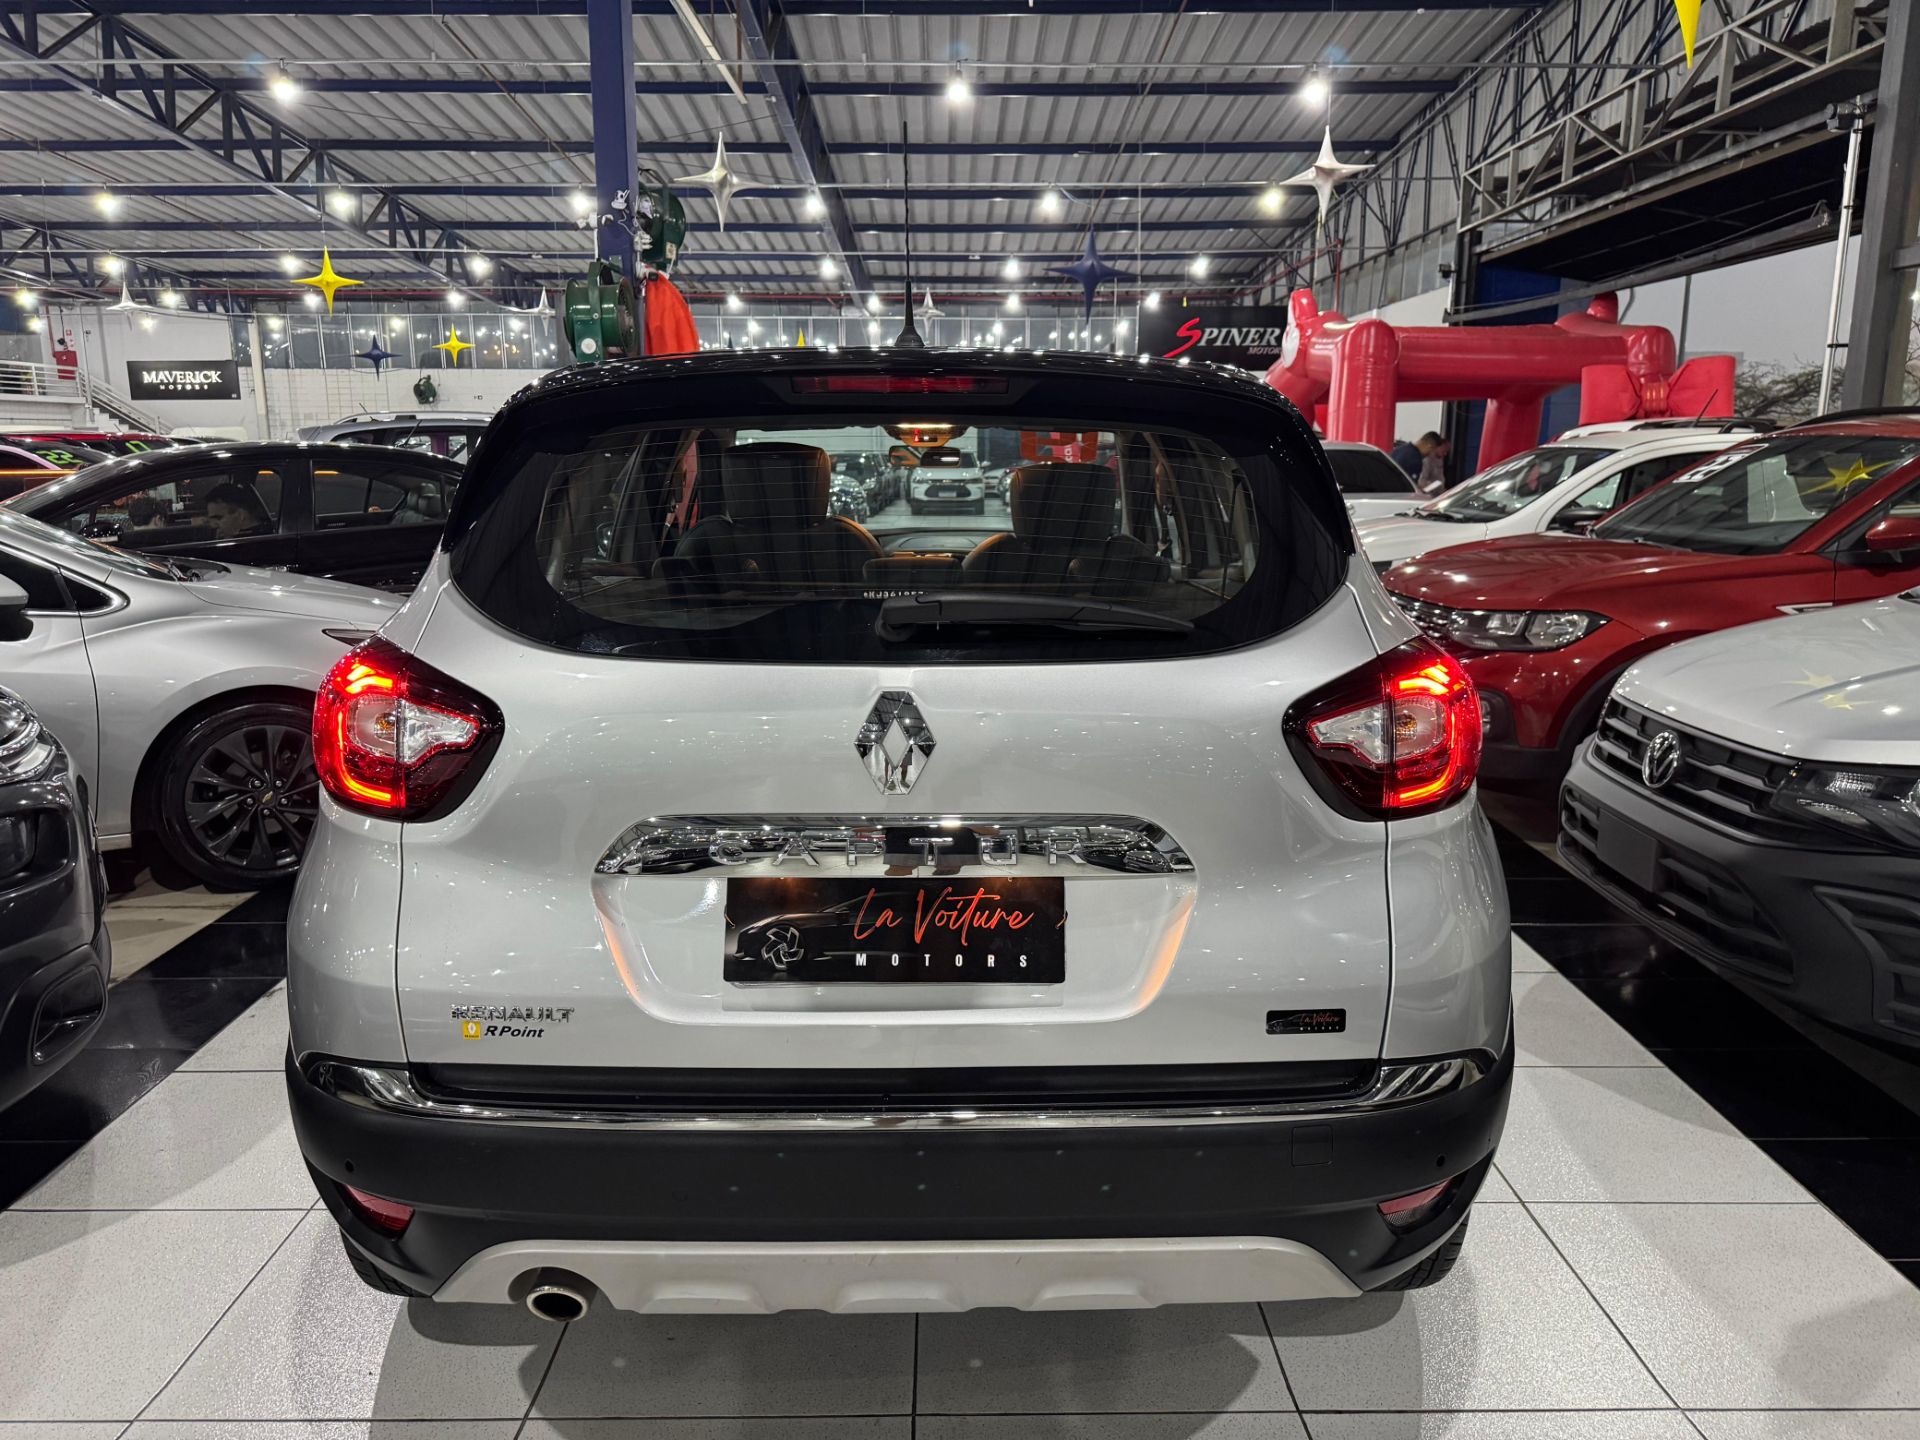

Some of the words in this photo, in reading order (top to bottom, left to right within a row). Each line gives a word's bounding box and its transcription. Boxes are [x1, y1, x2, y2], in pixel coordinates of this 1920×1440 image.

[1163, 317, 1281, 358] SPINER
[142, 371, 222, 383] MAVERICK
[707, 836, 1088, 866] CAPTUR
[853, 887, 902, 940] La
[914, 886, 1034, 946] Voiture
[855, 953, 1028, 968] MOTORS
[451, 1004, 575, 1022] RENAULT
